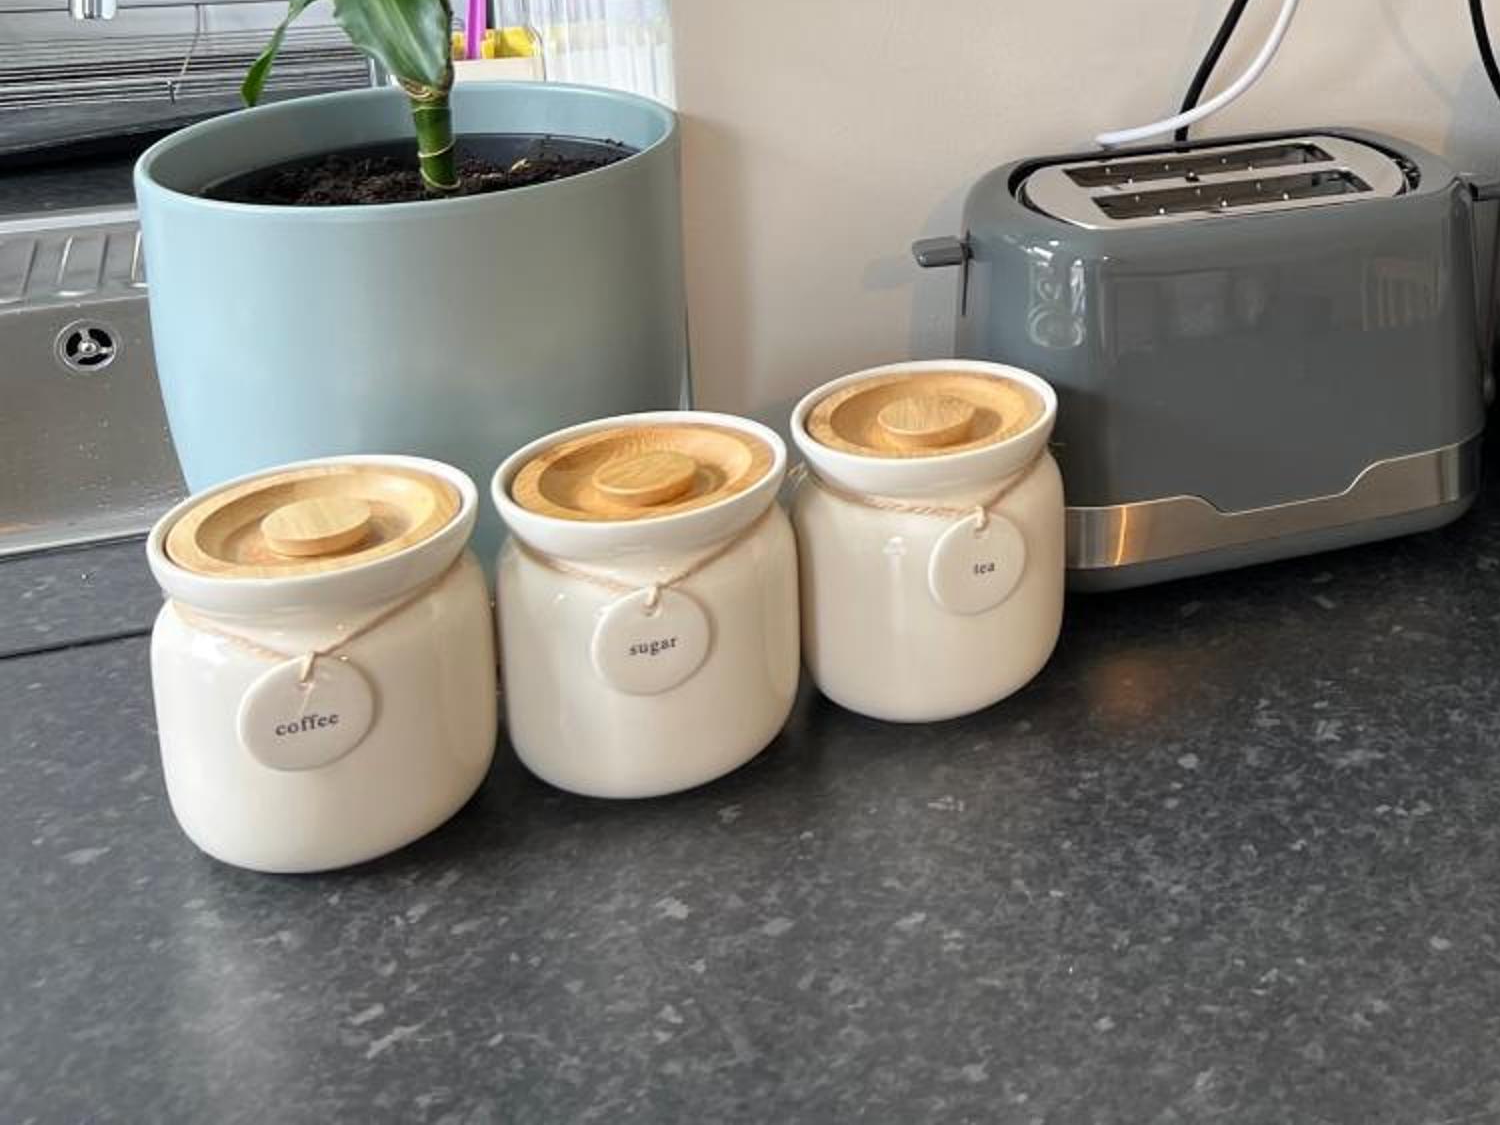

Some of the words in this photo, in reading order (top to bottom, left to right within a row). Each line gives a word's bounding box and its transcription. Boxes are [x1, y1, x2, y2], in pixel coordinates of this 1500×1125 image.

[974, 562, 995, 575] tea
[629, 636, 678, 657] sugar
[275, 713, 339, 736] coffee
